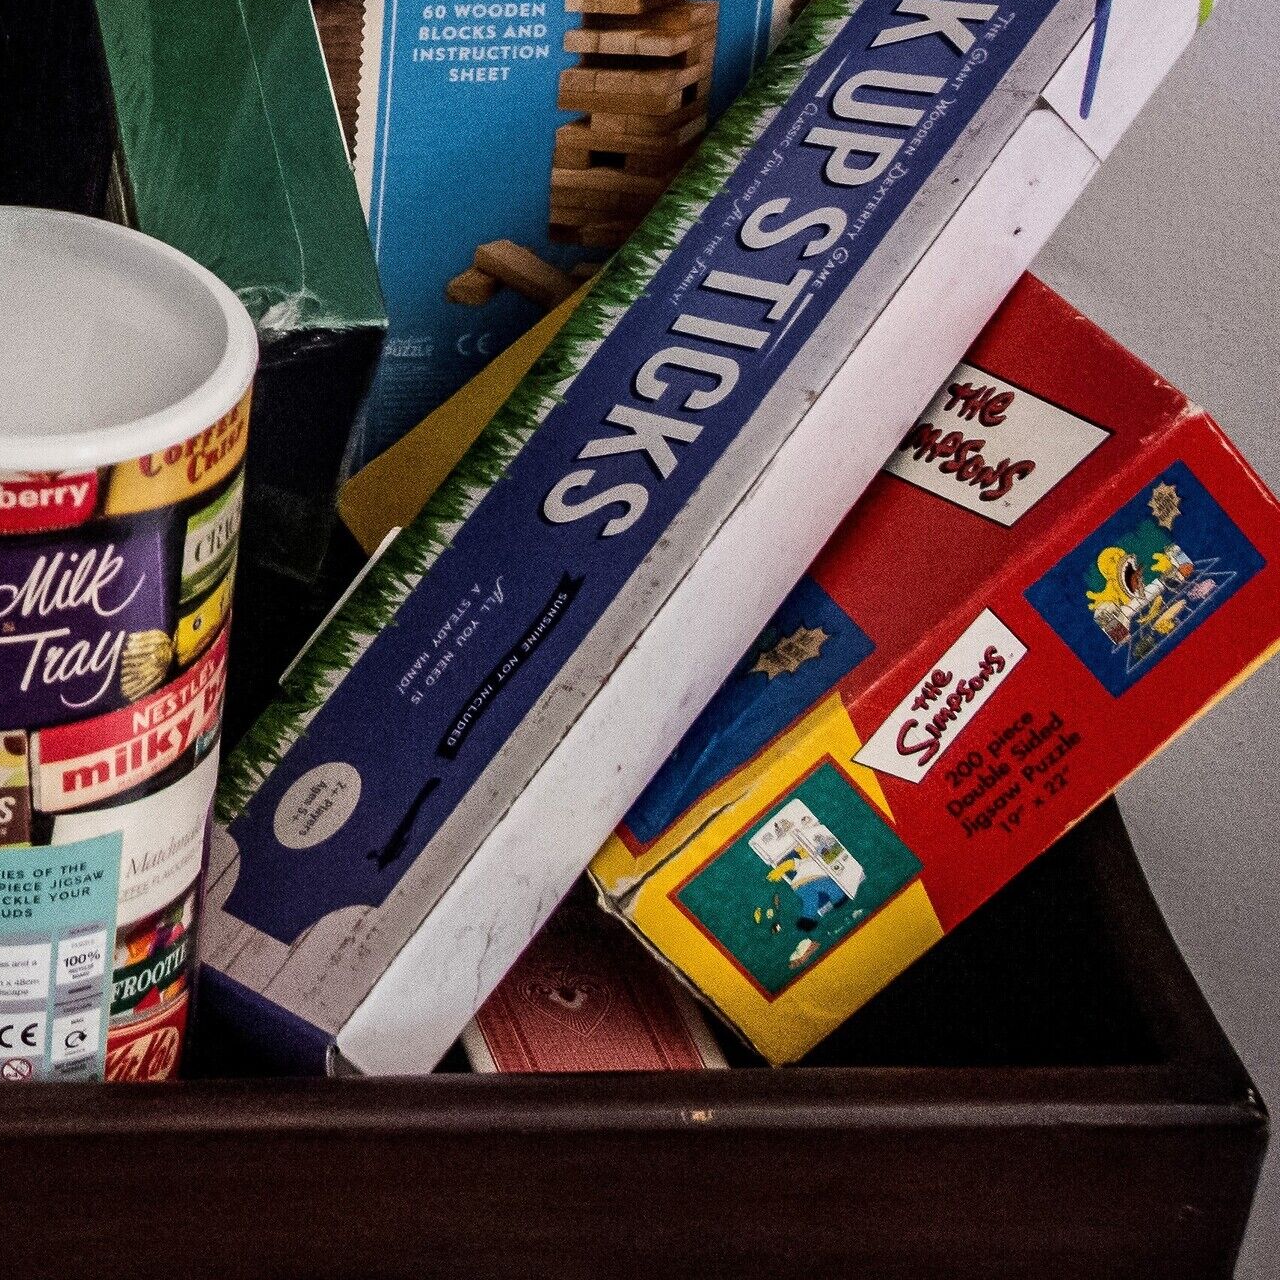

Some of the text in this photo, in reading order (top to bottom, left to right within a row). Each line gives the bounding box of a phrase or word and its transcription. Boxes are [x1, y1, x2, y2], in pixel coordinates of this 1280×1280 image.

[417, 22, 548, 41] BLOCKS AND
[422, 2, 546, 20] 60 WOODEN
[411, 44, 550, 62] INSTRUCTION
[448, 65, 510, 82] SHEET
[804, 67, 945, 189] UP
[812, 11, 1016, 289] THE GIANT WOODEN DEXTERITY GAME
[543, 195, 847, 538] STICKS
[944, 381, 1015, 427] THE
[899, 423, 1036, 502] MPSONS
[446, 592, 568, 746] SUNSHINE NOT INCLUDED
[911, 669, 953, 711] THE
[896, 645, 1006, 767] SIMPSONS
[62, 710, 196, 794] milky
[944, 711, 1034, 788] 200 piece
[945, 711, 1064, 819] Double Sided
[960, 731, 1082, 838] Jigsaw Puzzle
[33, 867, 53, 878] OF
[60, 861, 87, 874] THE
[48, 886, 91, 902] YOUR
[50, 870, 104, 891] JIGSAW
[63, 950, 101, 969] 100%
